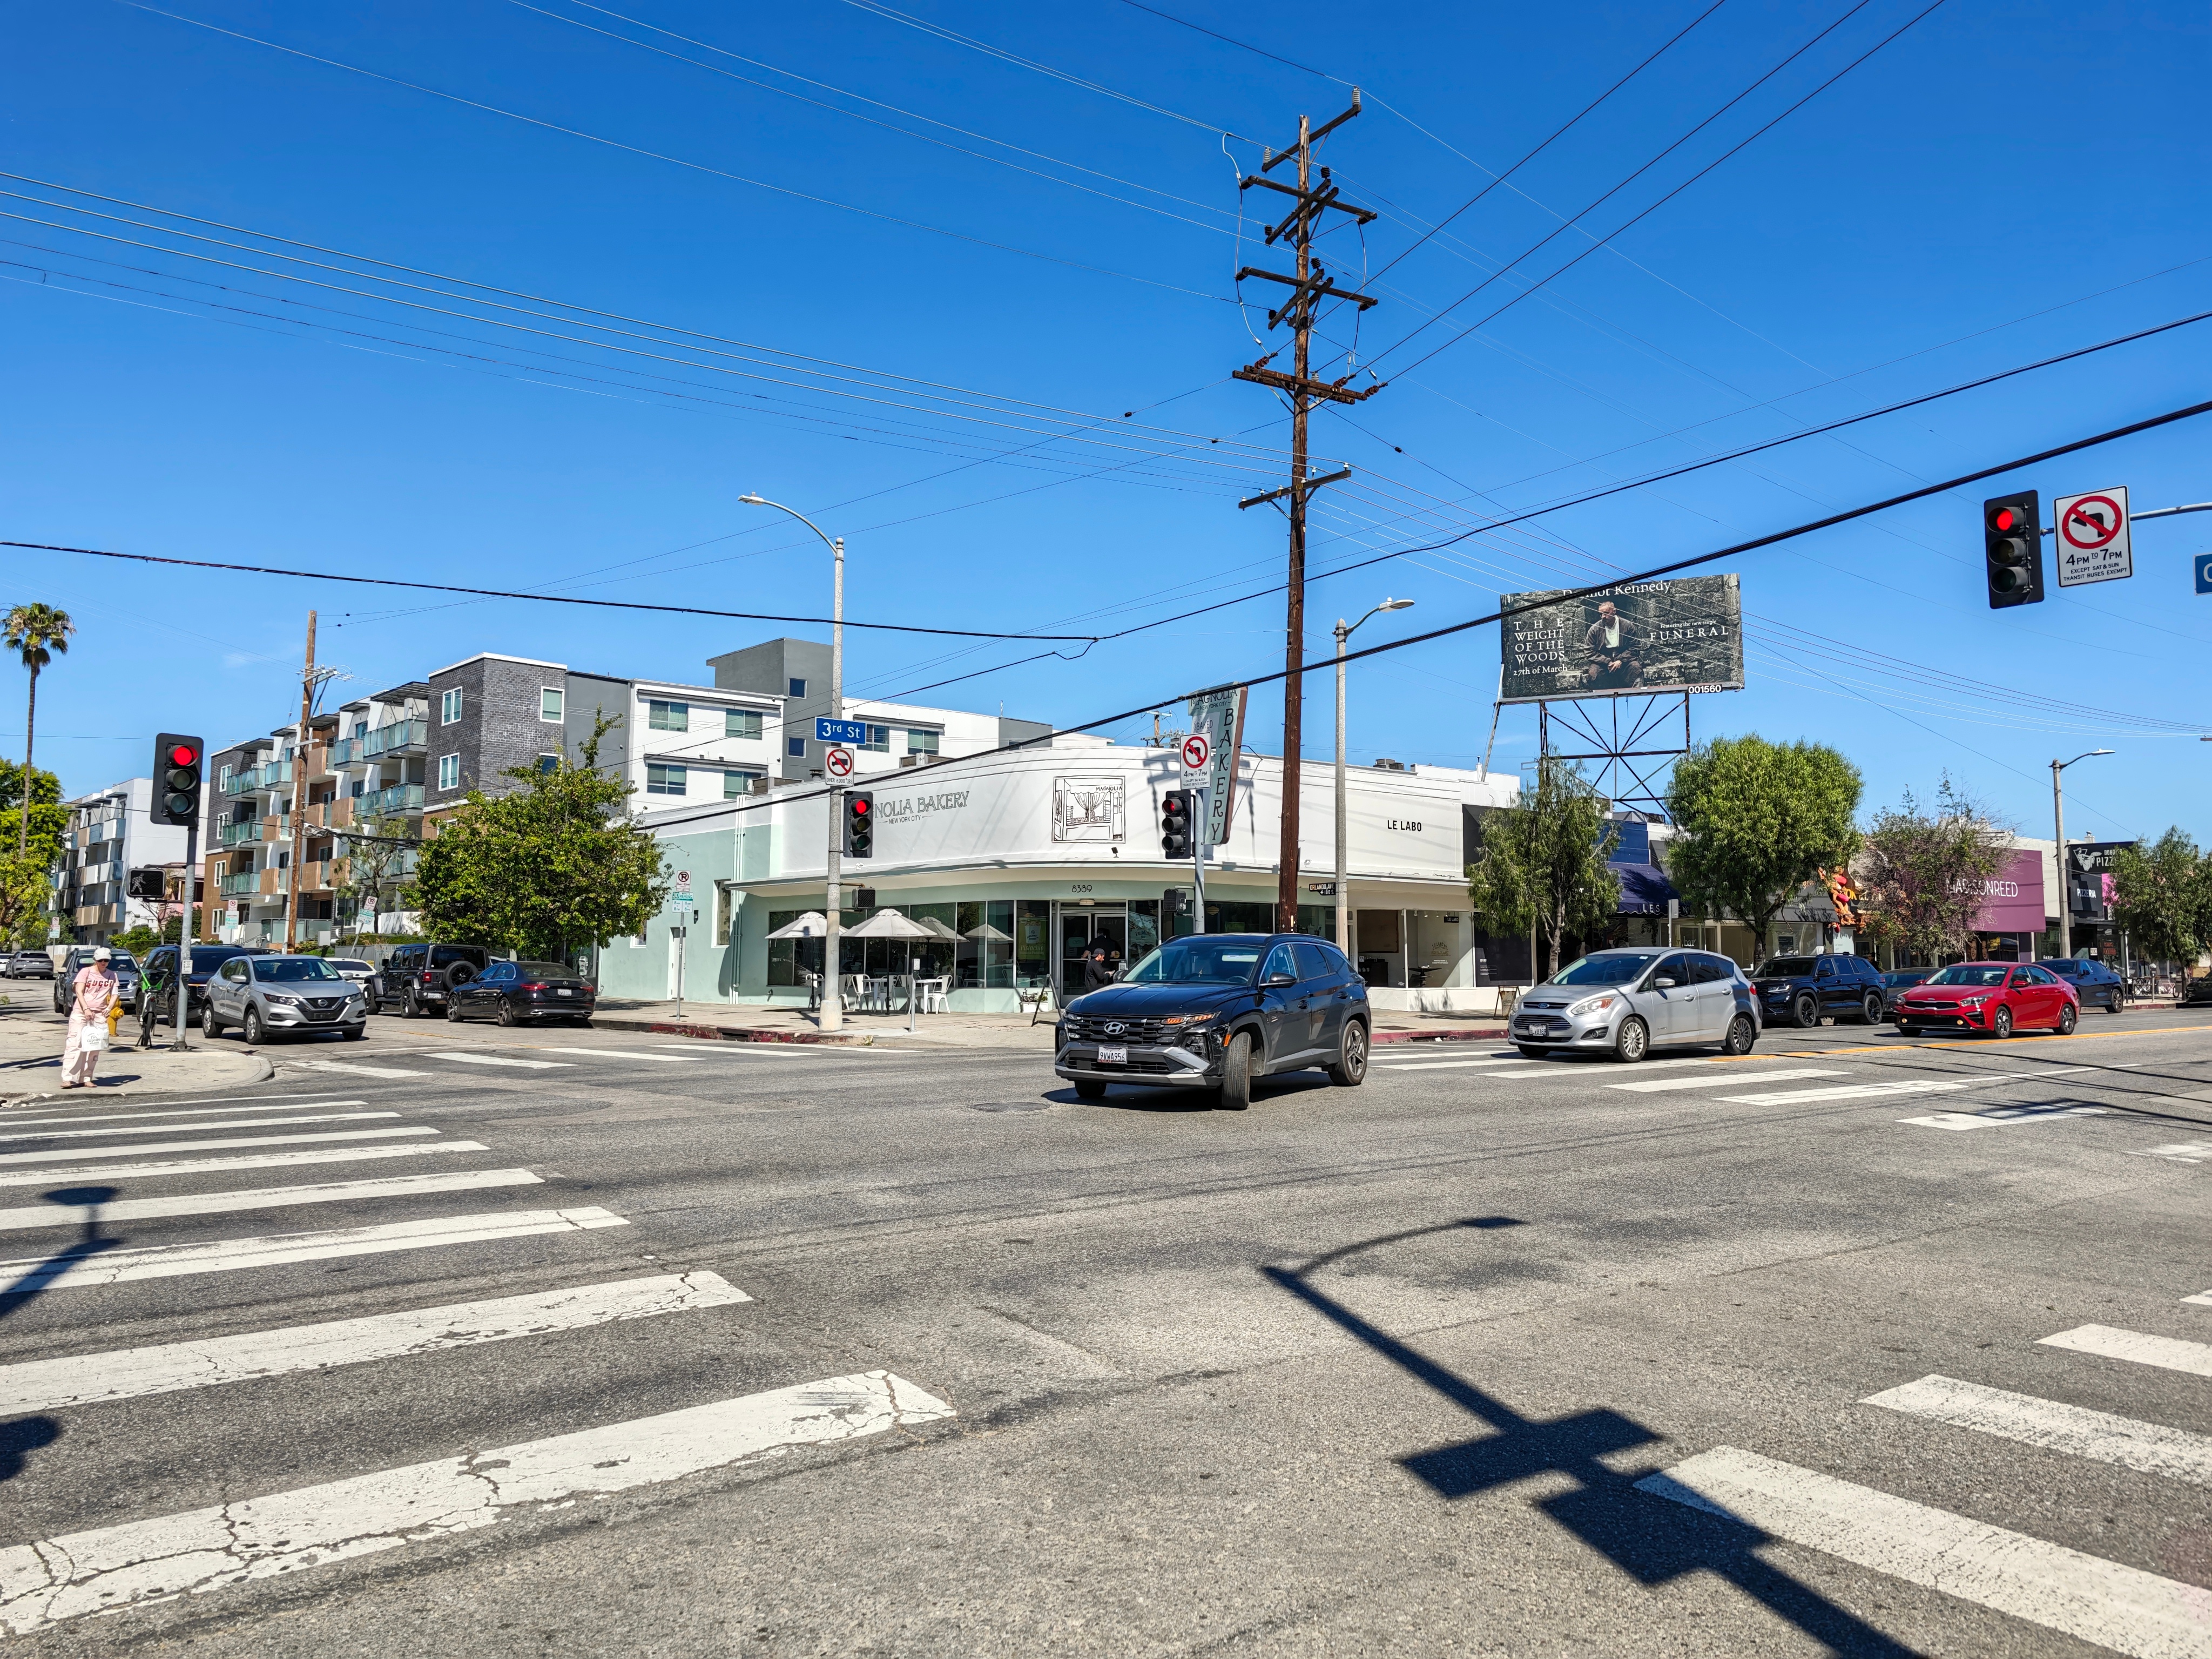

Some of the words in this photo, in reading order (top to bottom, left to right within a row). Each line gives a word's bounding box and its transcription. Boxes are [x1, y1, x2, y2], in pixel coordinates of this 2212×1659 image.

[2066, 554, 2089, 565] 4PM
[2100, 549, 2122, 561] 7PM
[1615, 581, 1671, 595] Kennedy
[1514, 629, 1564, 641] WEIGHT
[1649, 626, 1729, 641] FUNERAL
[1515, 643, 1533, 652] OF
[1537, 640, 1564, 650] THE
[1515, 651, 1565, 666] WOODS
[1513, 667, 1530, 677] 27th
[1532, 666, 1541, 674] of
[1542, 664, 1568, 673] March
[1688, 685, 1722, 694] 001560
[822, 722, 842, 737] 3rd
[847, 726, 860, 738] St
[1196, 720, 1213, 731] BAKED
[1211, 708, 1235, 840] BAKERY
[918, 791, 970, 813] BAKERY
[1387, 820, 1398, 830] LE
[1400, 820, 1422, 832] LABO
[1071, 885, 1092, 893] 8389
[2076, 888, 2096, 898] PIZZERIA
[1643, 903, 1660, 912] LES
[85, 980, 113, 988] GUCCI
[1100, 1051, 1125, 1061] 9VWA956
